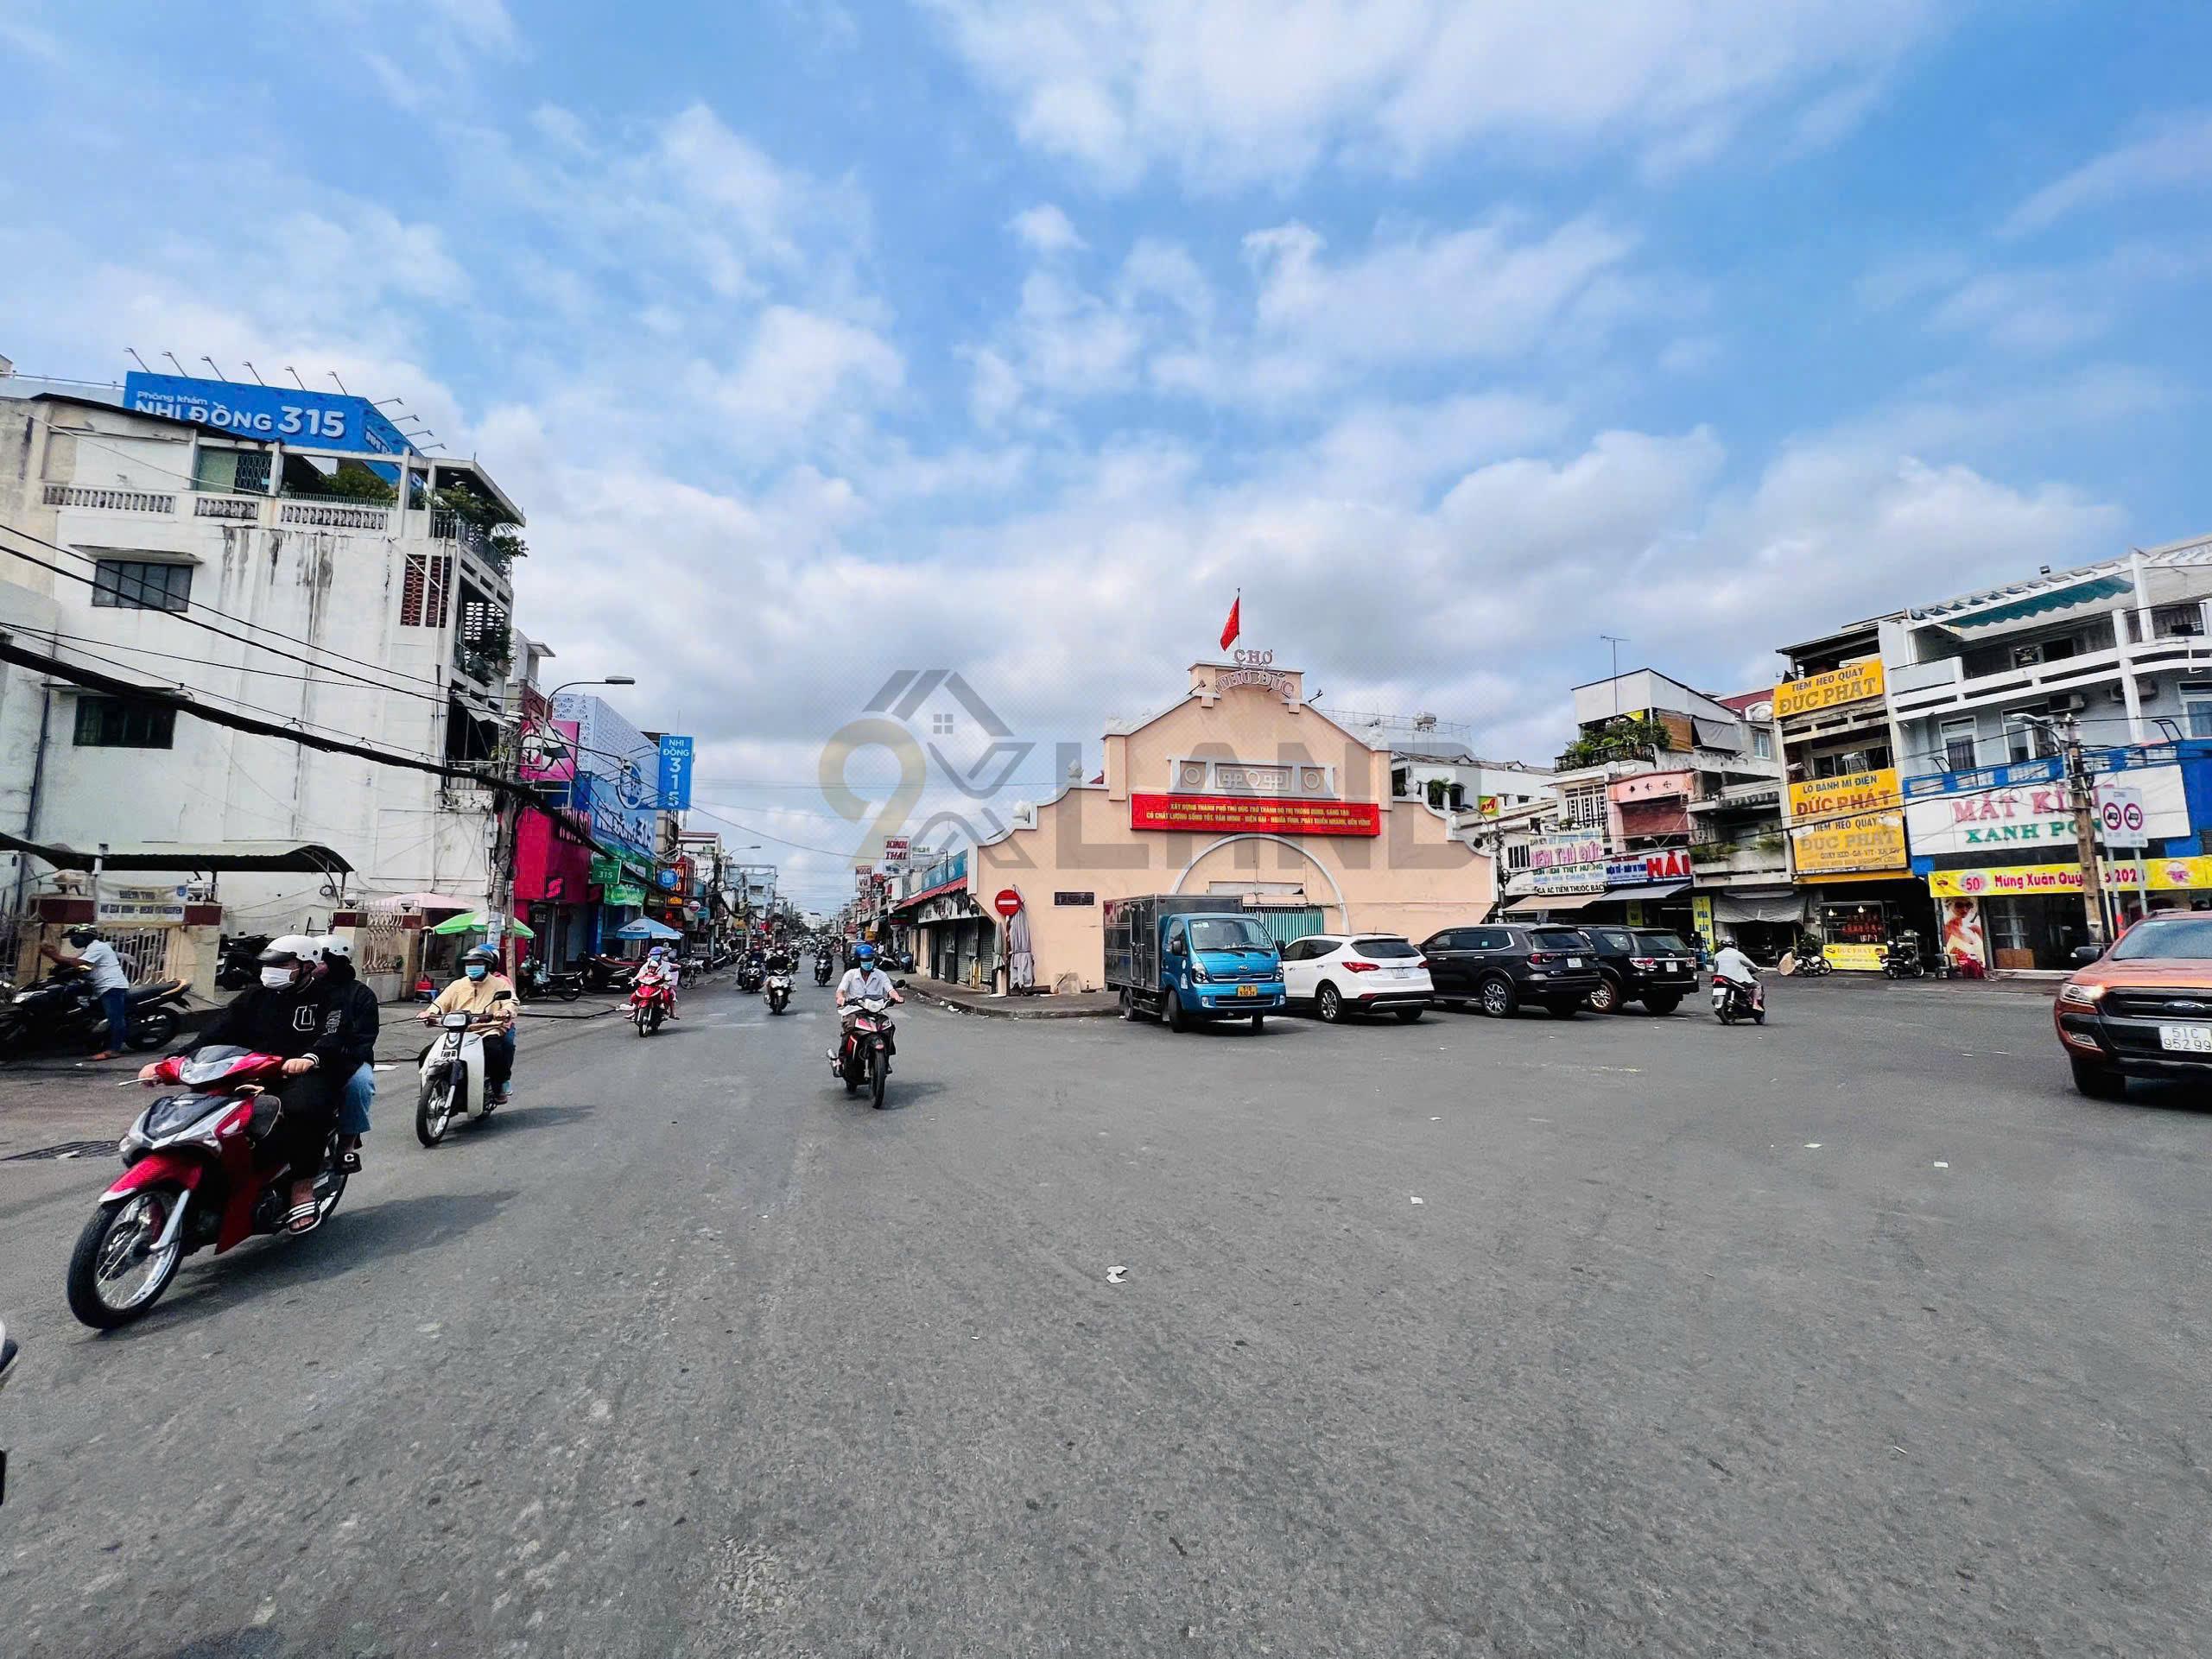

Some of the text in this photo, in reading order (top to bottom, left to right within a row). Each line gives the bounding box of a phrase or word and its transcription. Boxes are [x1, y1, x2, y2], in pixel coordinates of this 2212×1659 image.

[137, 390, 208, 406] Phòng khám
[135, 400, 345, 439] NHI ĐỒNG 315
[1816, 674, 1835, 687] HEO
[1838, 666, 1865, 682] QUAY
[1835, 820, 1851, 830] HEO
[1855, 817, 1878, 830] QUAY
[1966, 821, 2040, 844] XANH
[2114, 868, 2145, 883] 202
[2171, 1027, 2200, 1039] 51C
